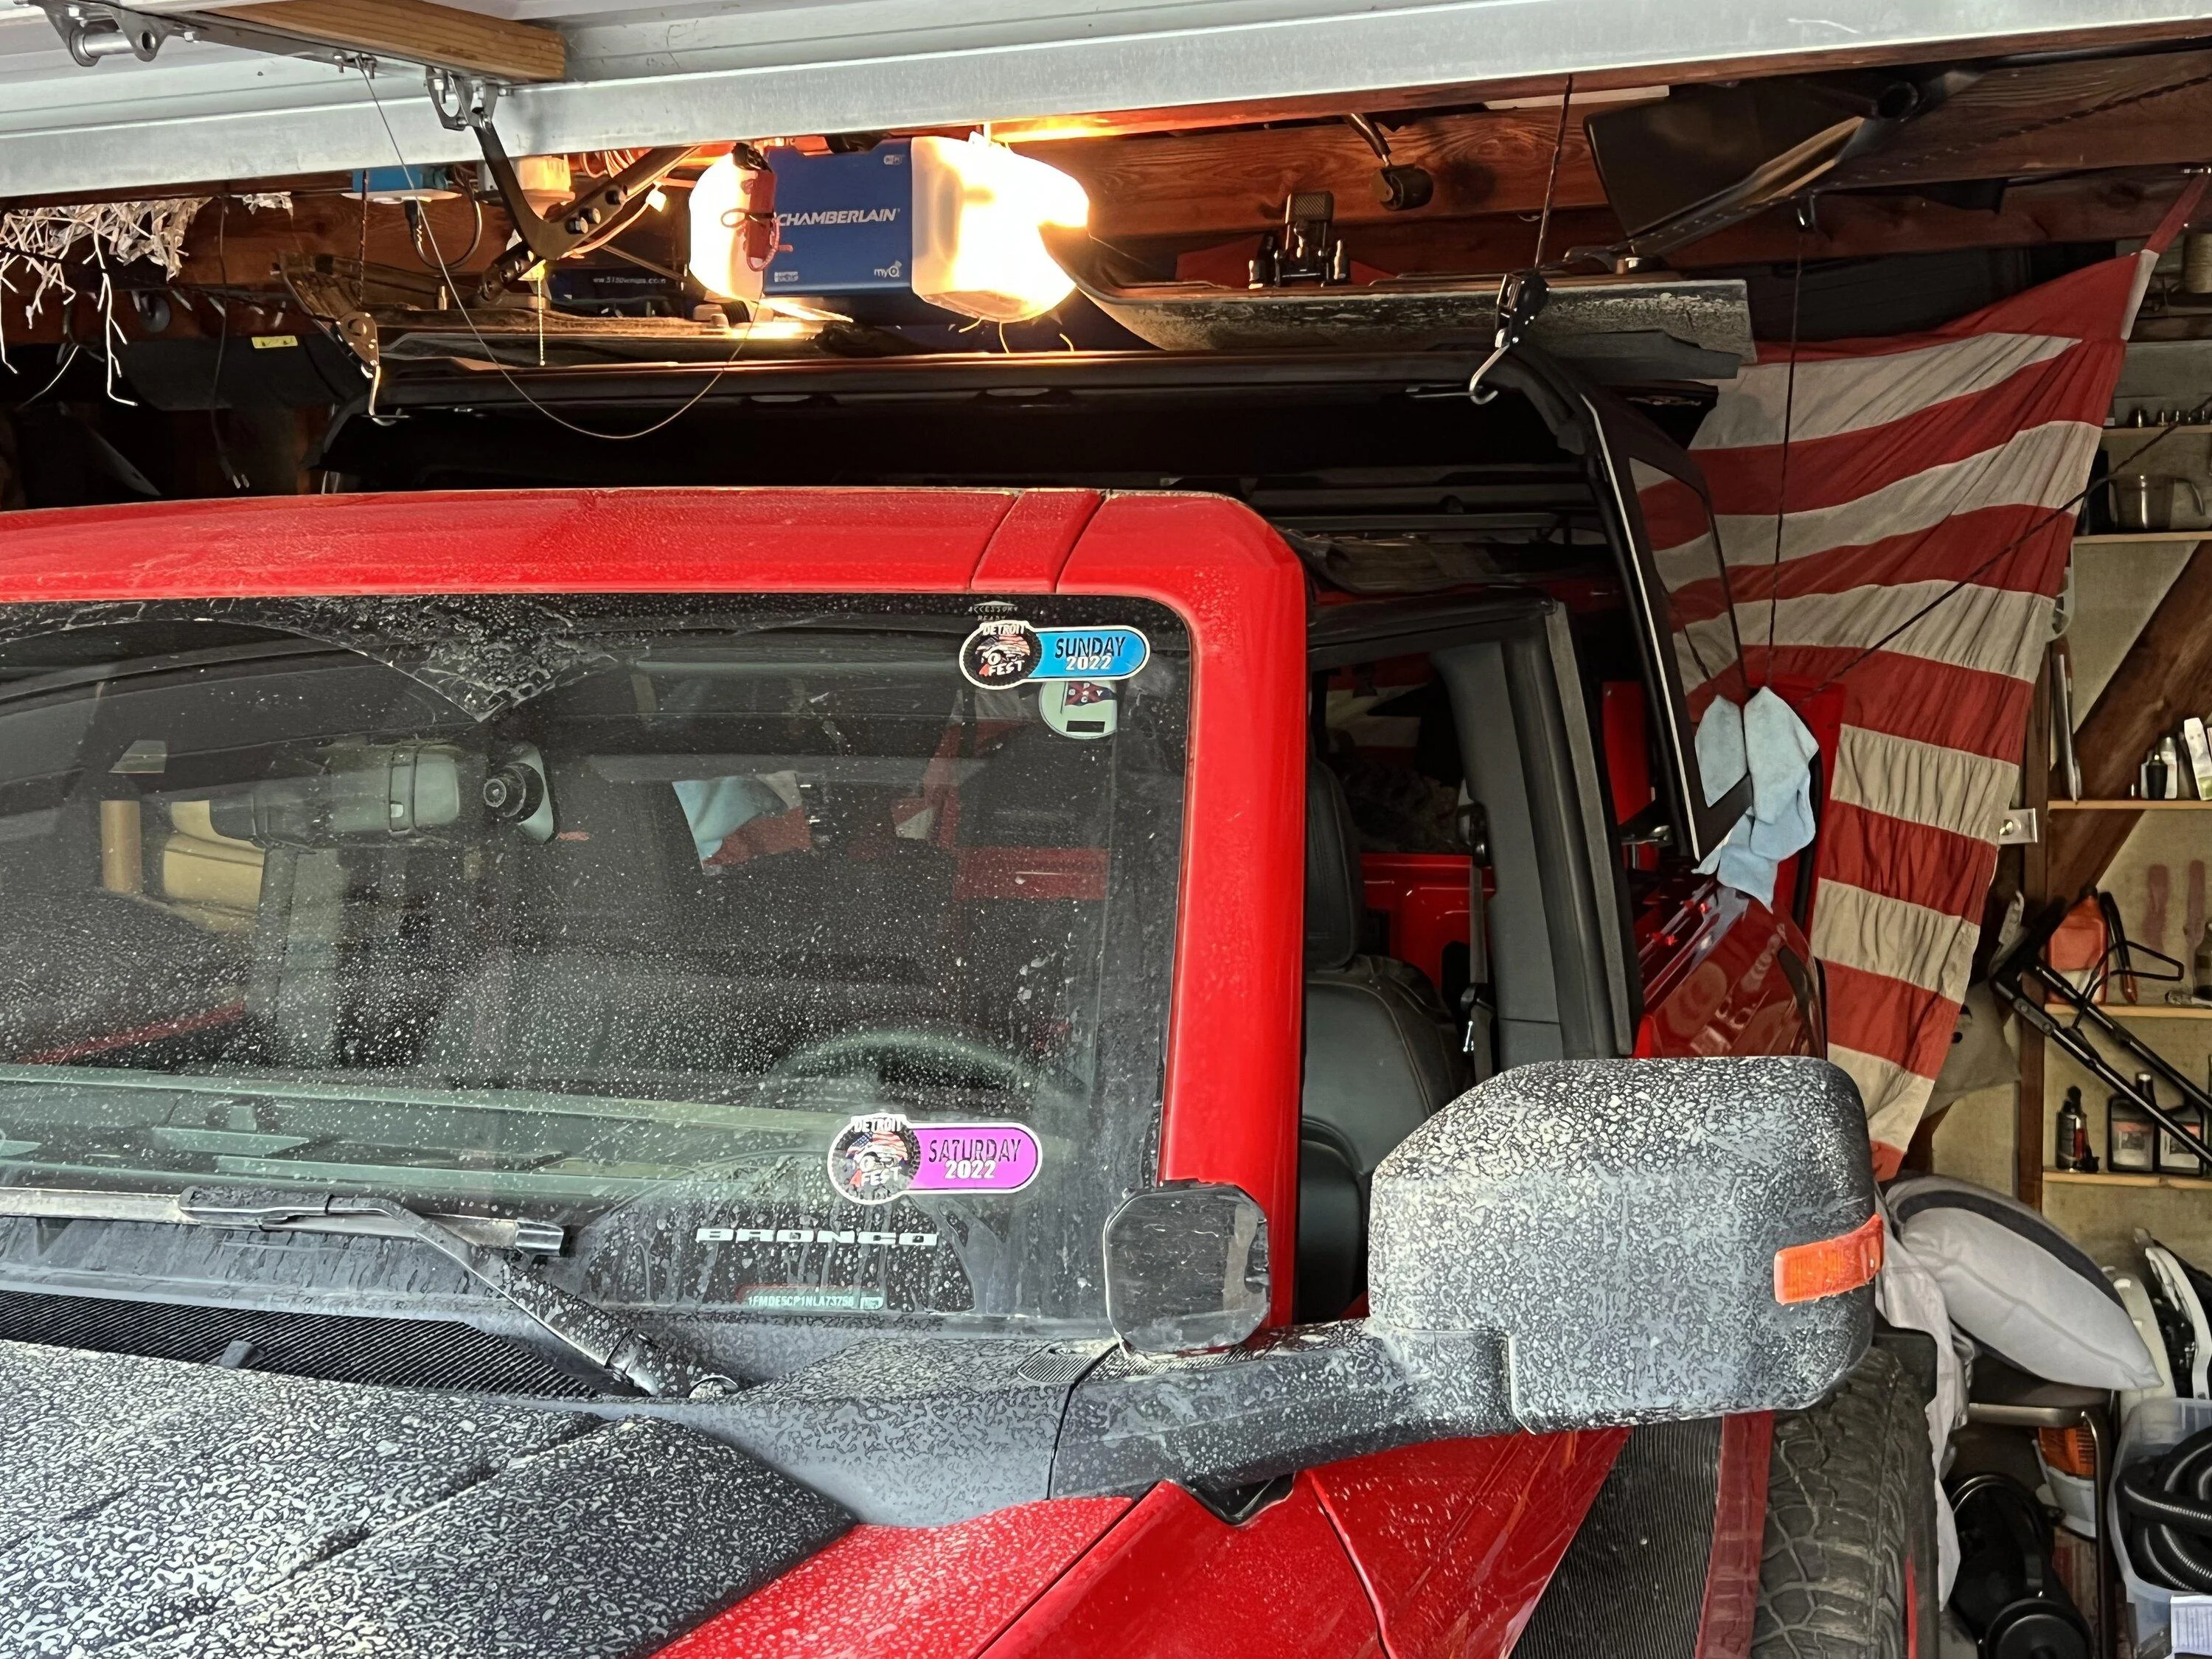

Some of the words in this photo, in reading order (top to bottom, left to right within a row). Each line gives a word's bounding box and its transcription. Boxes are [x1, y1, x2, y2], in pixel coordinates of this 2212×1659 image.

[779, 209, 897, 226] CHAMBERLAIN
[874, 263, 900, 278] myQ
[983, 623, 1025, 636] DETROIT
[1054, 636, 1126, 658] SUNDAY
[1065, 655, 1113, 671] 2022
[854, 1118, 902, 1133] DETROIT
[928, 1138, 1021, 1163] SATURDAY
[944, 1159, 998, 1180] 2022
[695, 1228, 939, 1246] BRONCO
